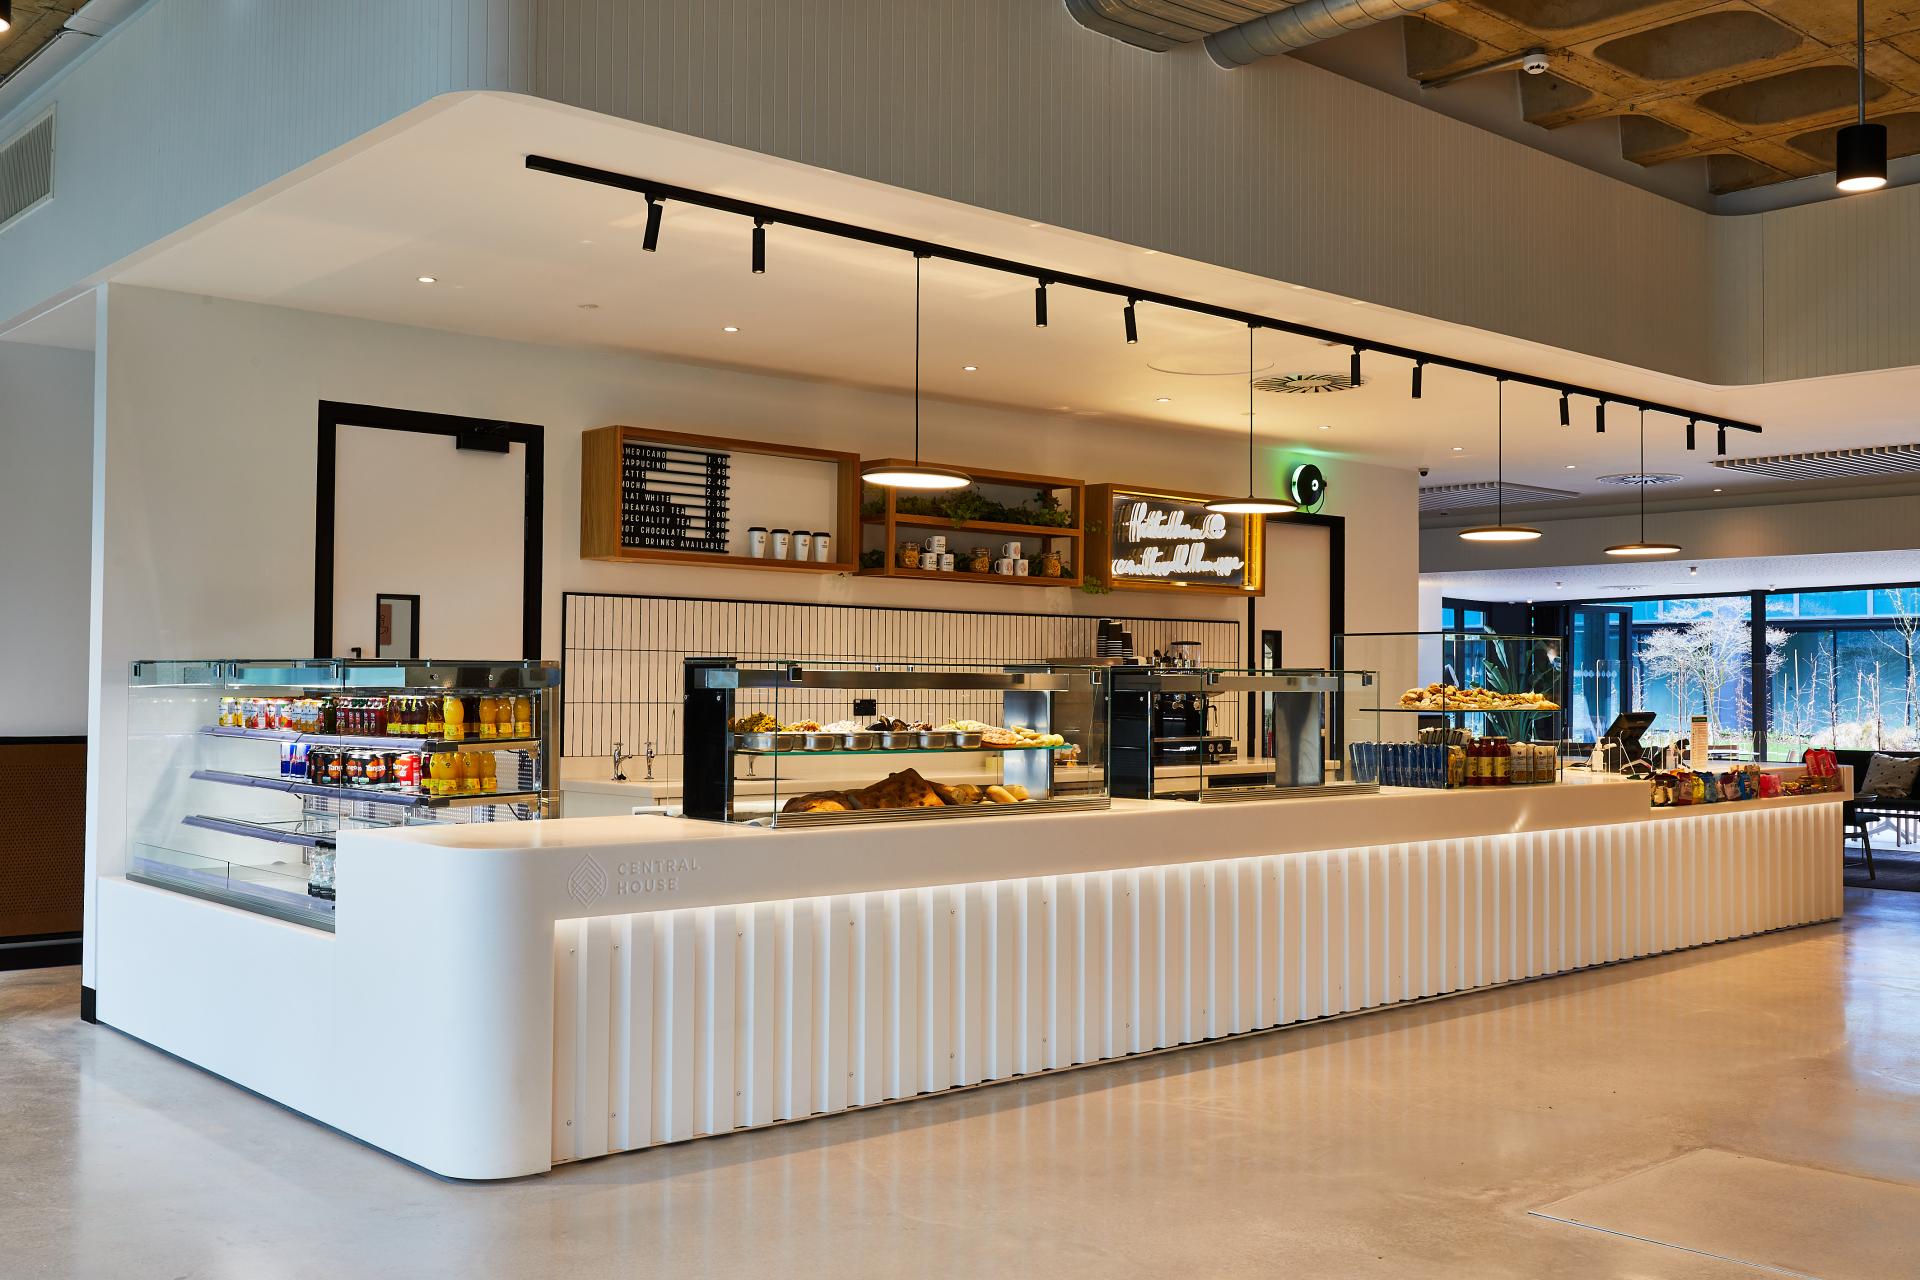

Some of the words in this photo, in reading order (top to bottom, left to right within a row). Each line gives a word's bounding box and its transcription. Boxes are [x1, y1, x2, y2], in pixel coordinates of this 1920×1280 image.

[622, 447, 666, 459] MERICANO
[708, 456, 727, 465] 1.90
[624, 469, 645, 479] ATTE
[707, 478, 726, 486] 2.45
[707, 467, 726, 475] 2.45
[625, 491, 640, 500] LAT
[645, 493, 670, 503] WHITE
[706, 499, 726, 507] 2.30
[706, 488, 725, 497] 2.65
[671, 506, 685, 515] TEA
[707, 510, 726, 518] 1.60
[676, 518, 690, 526] TEA
[707, 520, 725, 529] 1.80
[640, 526, 686, 537] CHOCOLATE
[706, 531, 725, 540] 2.40
[645, 537, 675, 547] DRINKS
[680, 540, 725, 550] AVAILABLE
[617, 858, 701, 876] CENTRAL
[617, 878, 680, 895] HOUSE
